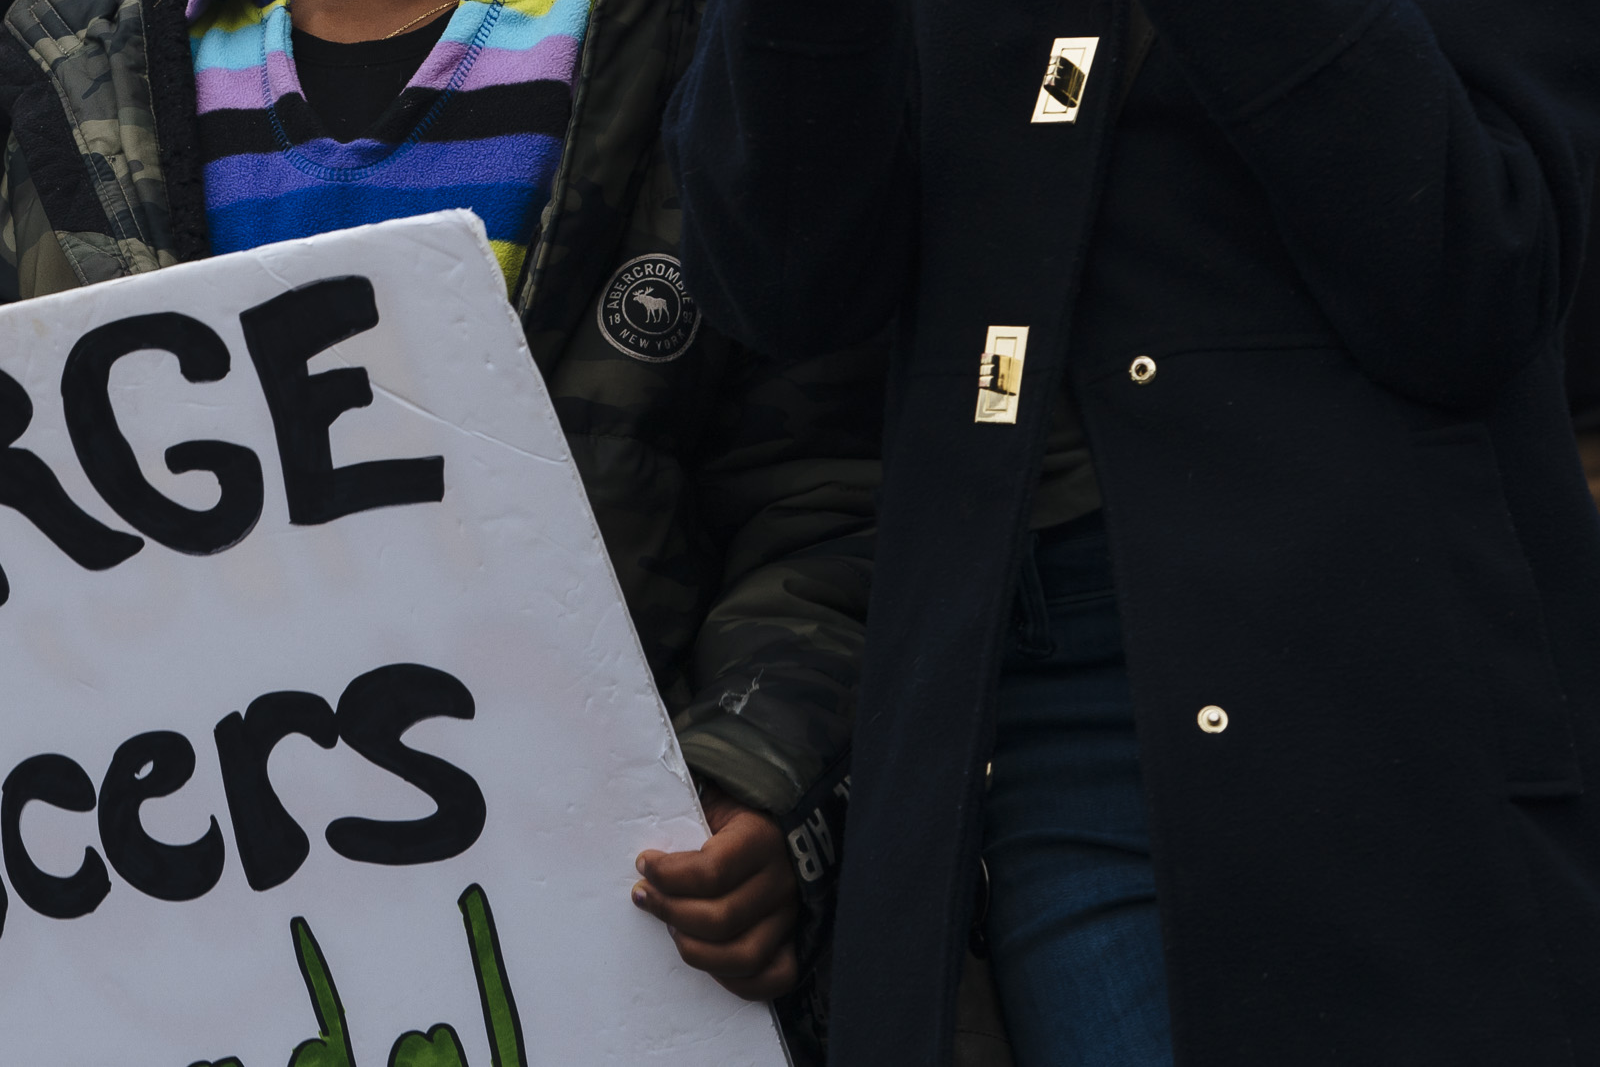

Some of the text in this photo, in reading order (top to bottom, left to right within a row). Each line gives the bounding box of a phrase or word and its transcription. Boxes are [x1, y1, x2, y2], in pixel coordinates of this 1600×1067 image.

[609, 313, 621, 325] 18
[620, 329, 685, 350] NEW YORK
